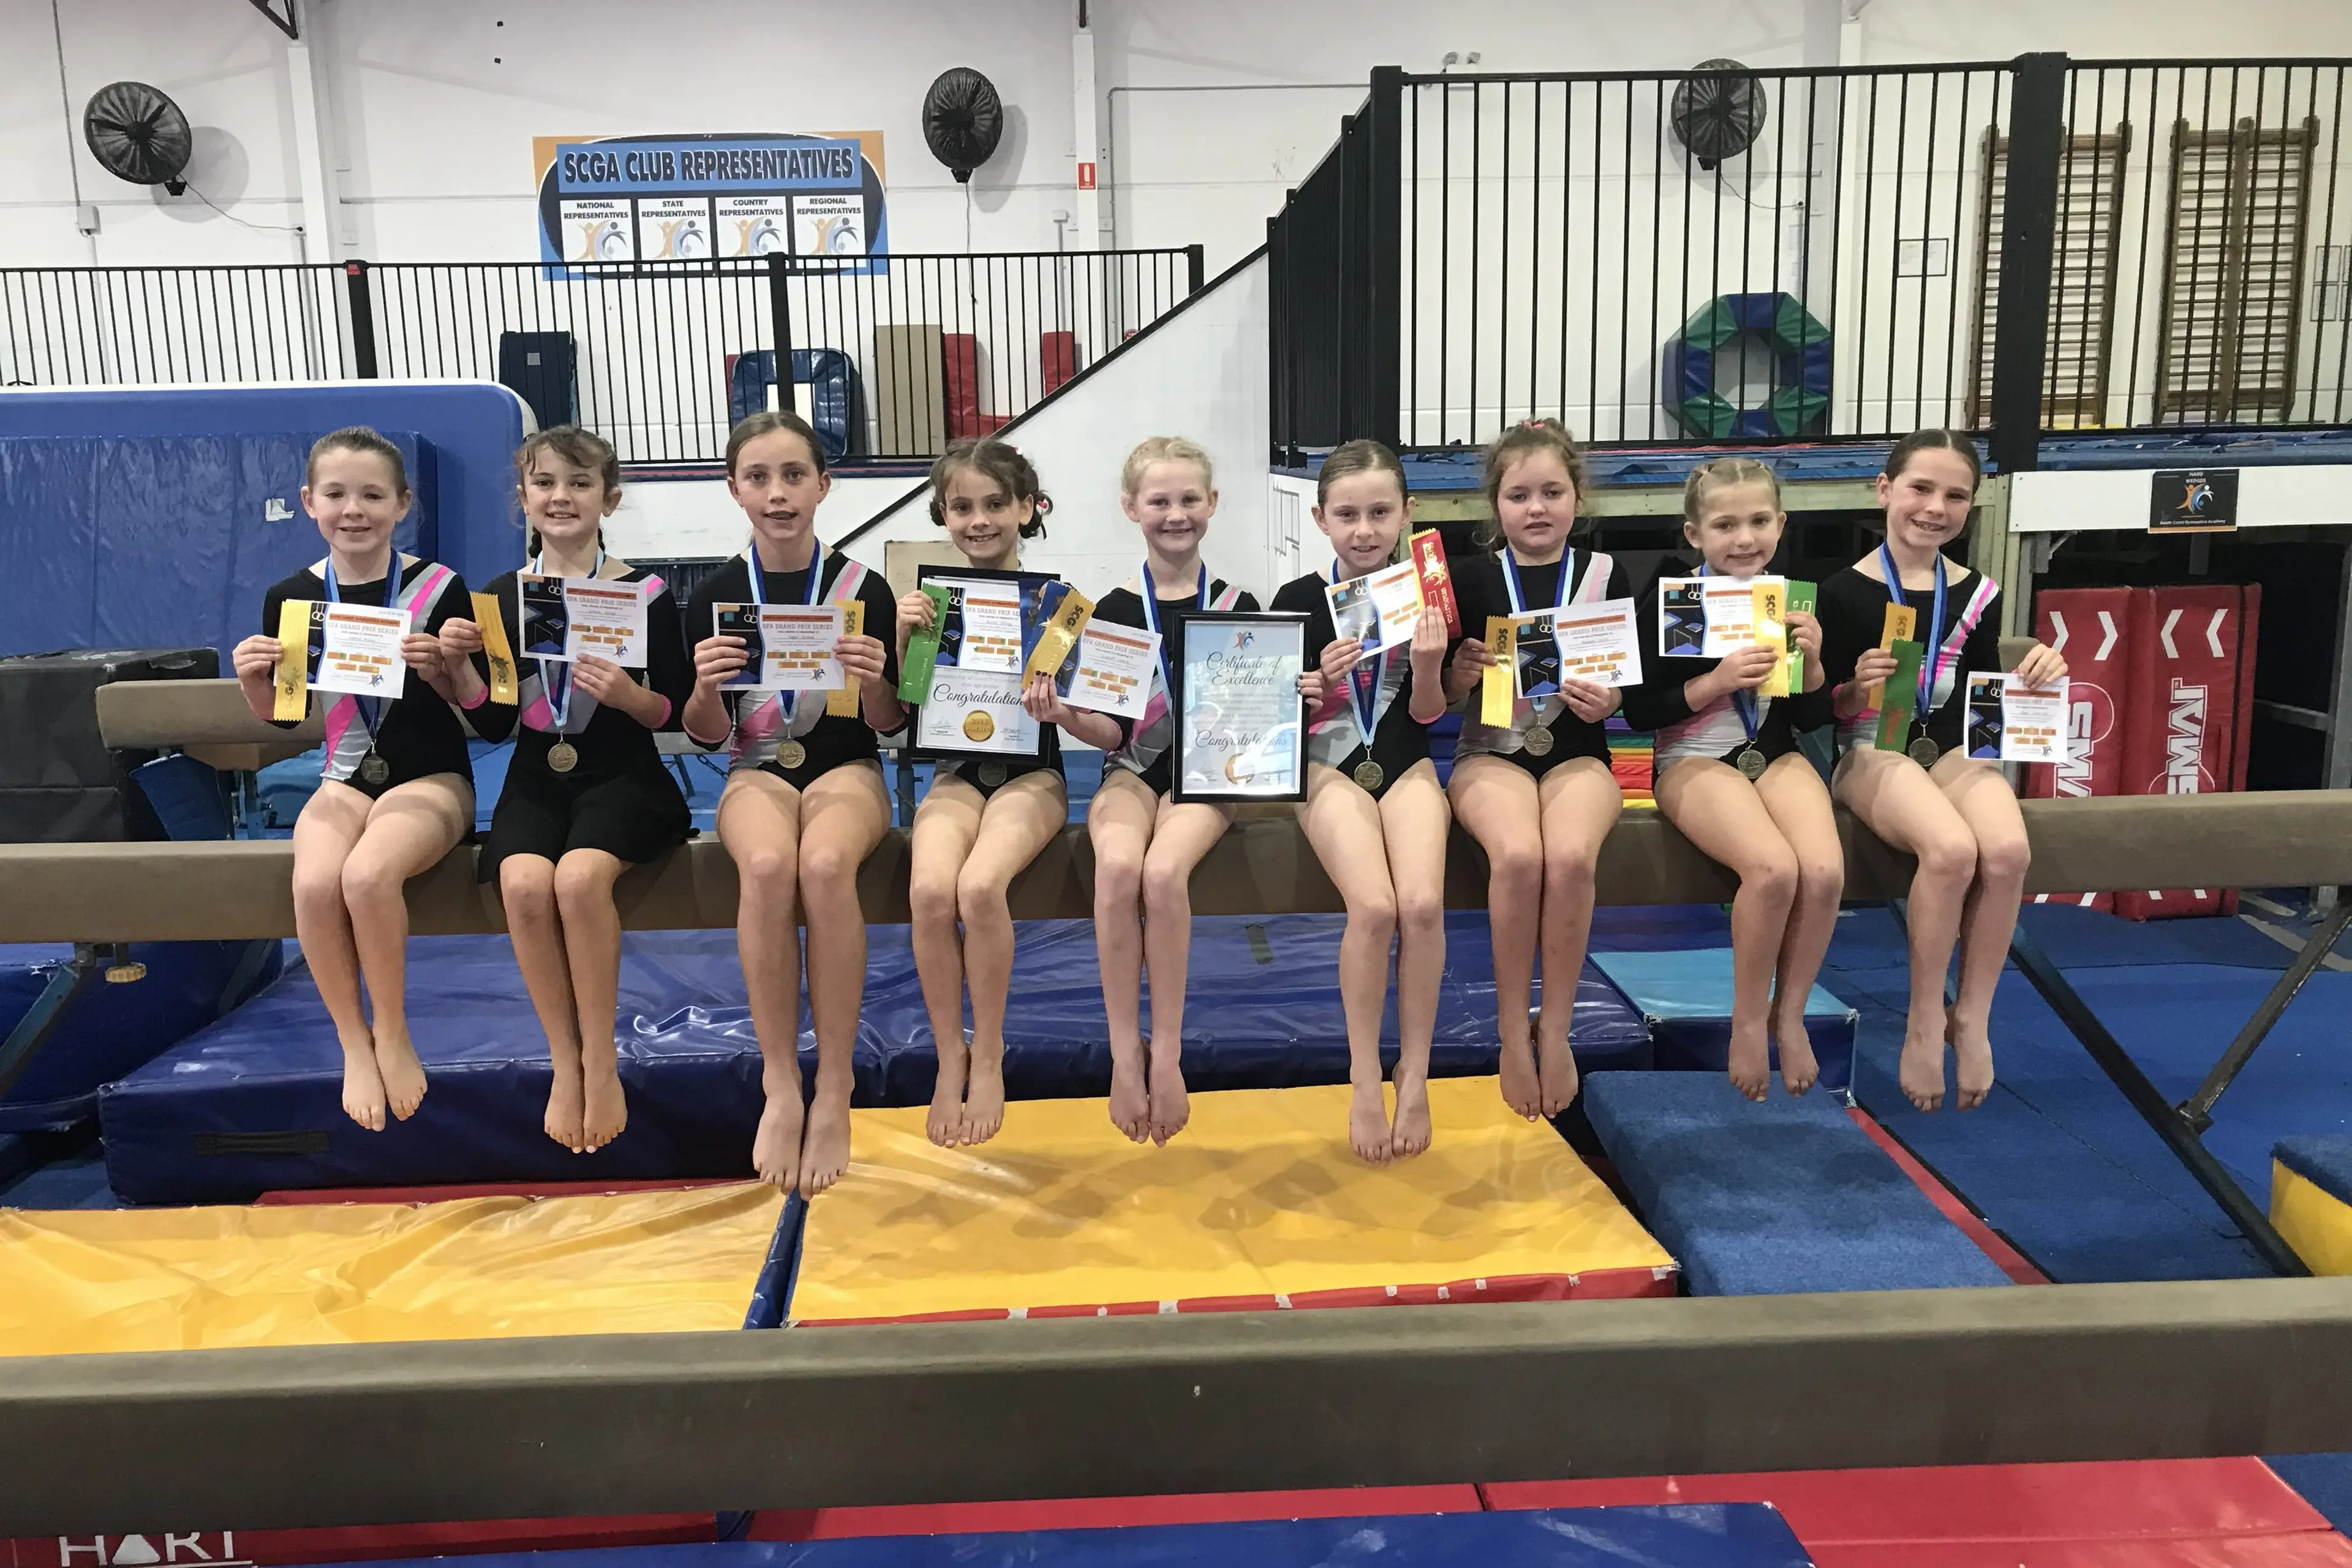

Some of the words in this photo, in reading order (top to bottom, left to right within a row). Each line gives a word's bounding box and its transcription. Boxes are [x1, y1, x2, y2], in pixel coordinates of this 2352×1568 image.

[564, 151, 622, 183] SCGA
[625, 150, 676, 182] CLUB
[681, 147, 853, 181] REPRESENTATIVES
[564, 211, 629, 220] REPRESENTATIVES
[641, 209, 706, 218] REPRESENTATIVES
[719, 208, 784, 216] REPRESENTATIVES
[796, 206, 861, 215] REPRESENTATIVES
[846, 611, 856, 633] SCG
[1207, 651, 1264, 675] Certificate
[1268, 655, 1283, 675] of
[1212, 668, 1274, 686] Excellence
[933, 683, 1023, 707] Congratulation
